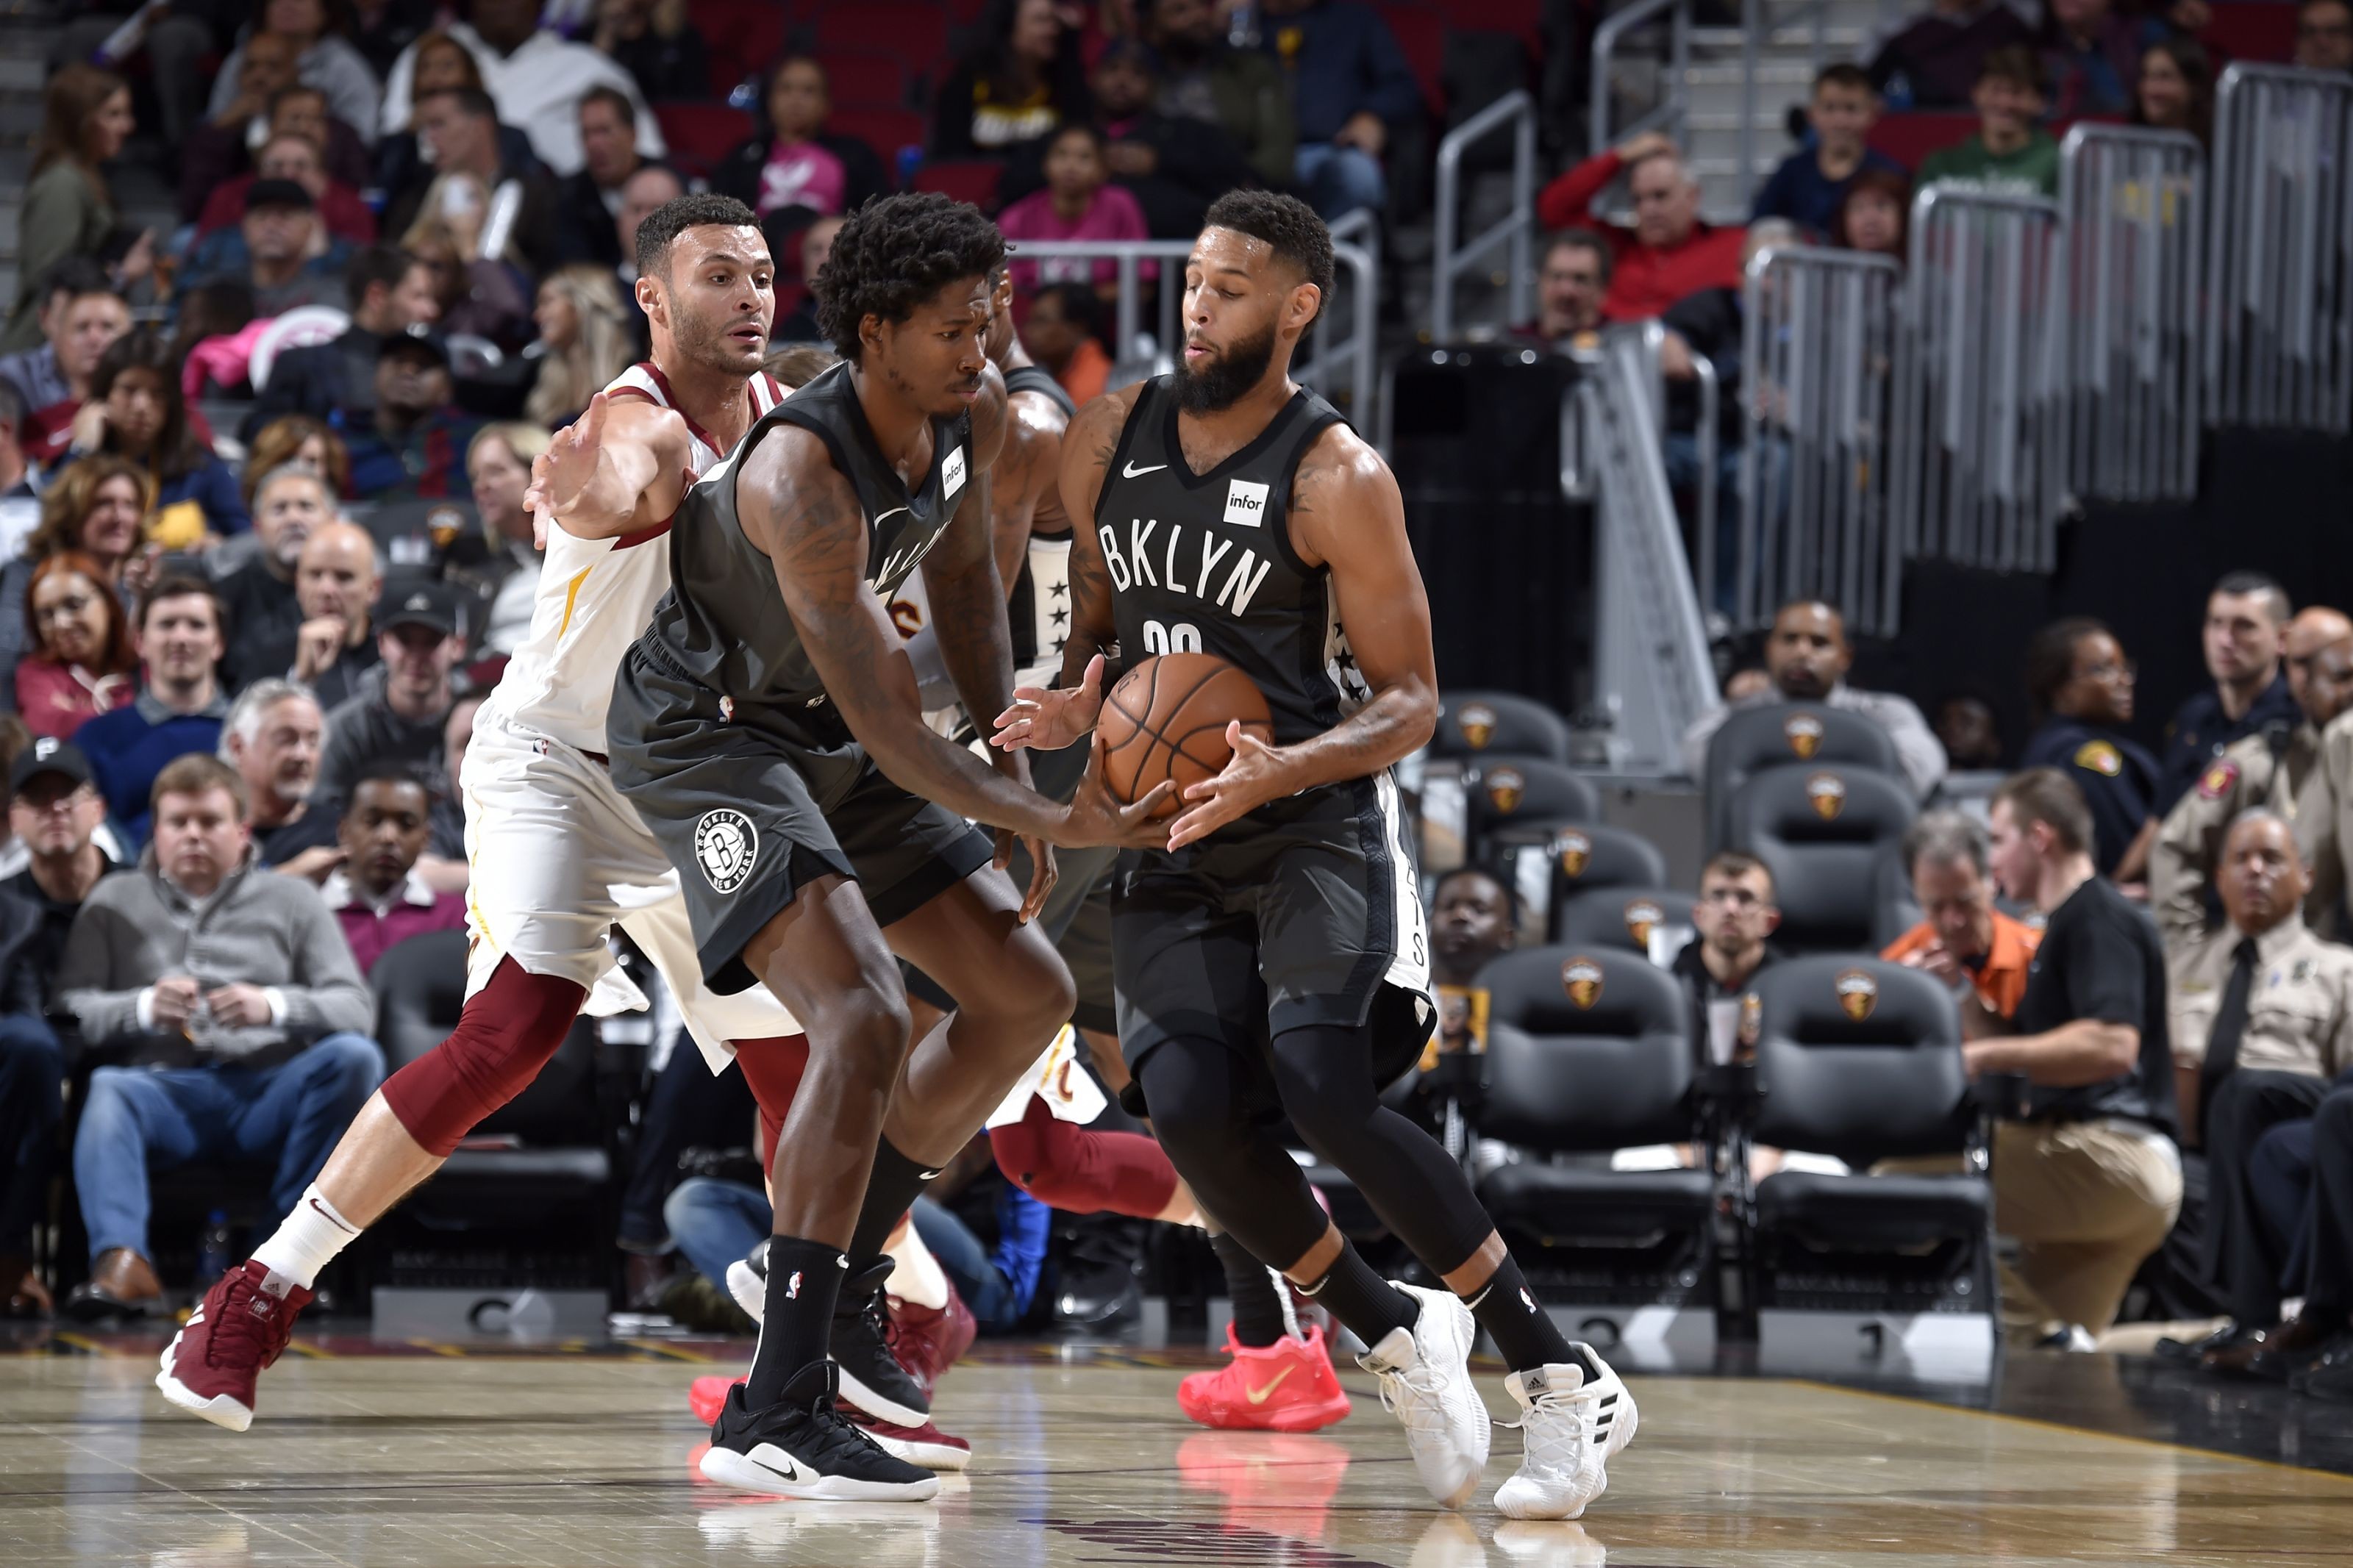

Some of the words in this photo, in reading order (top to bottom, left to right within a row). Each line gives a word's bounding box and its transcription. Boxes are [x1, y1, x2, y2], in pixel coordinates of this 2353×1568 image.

[944, 462, 963, 485] infor
[1230, 493, 1262, 510] infor
[1099, 519, 1271, 617] BKLYN
[697, 812, 745, 857] BROOKLYN
[711, 832, 733, 872] B
[713, 877, 732, 889] NEW
[733, 849, 754, 882] YORK
